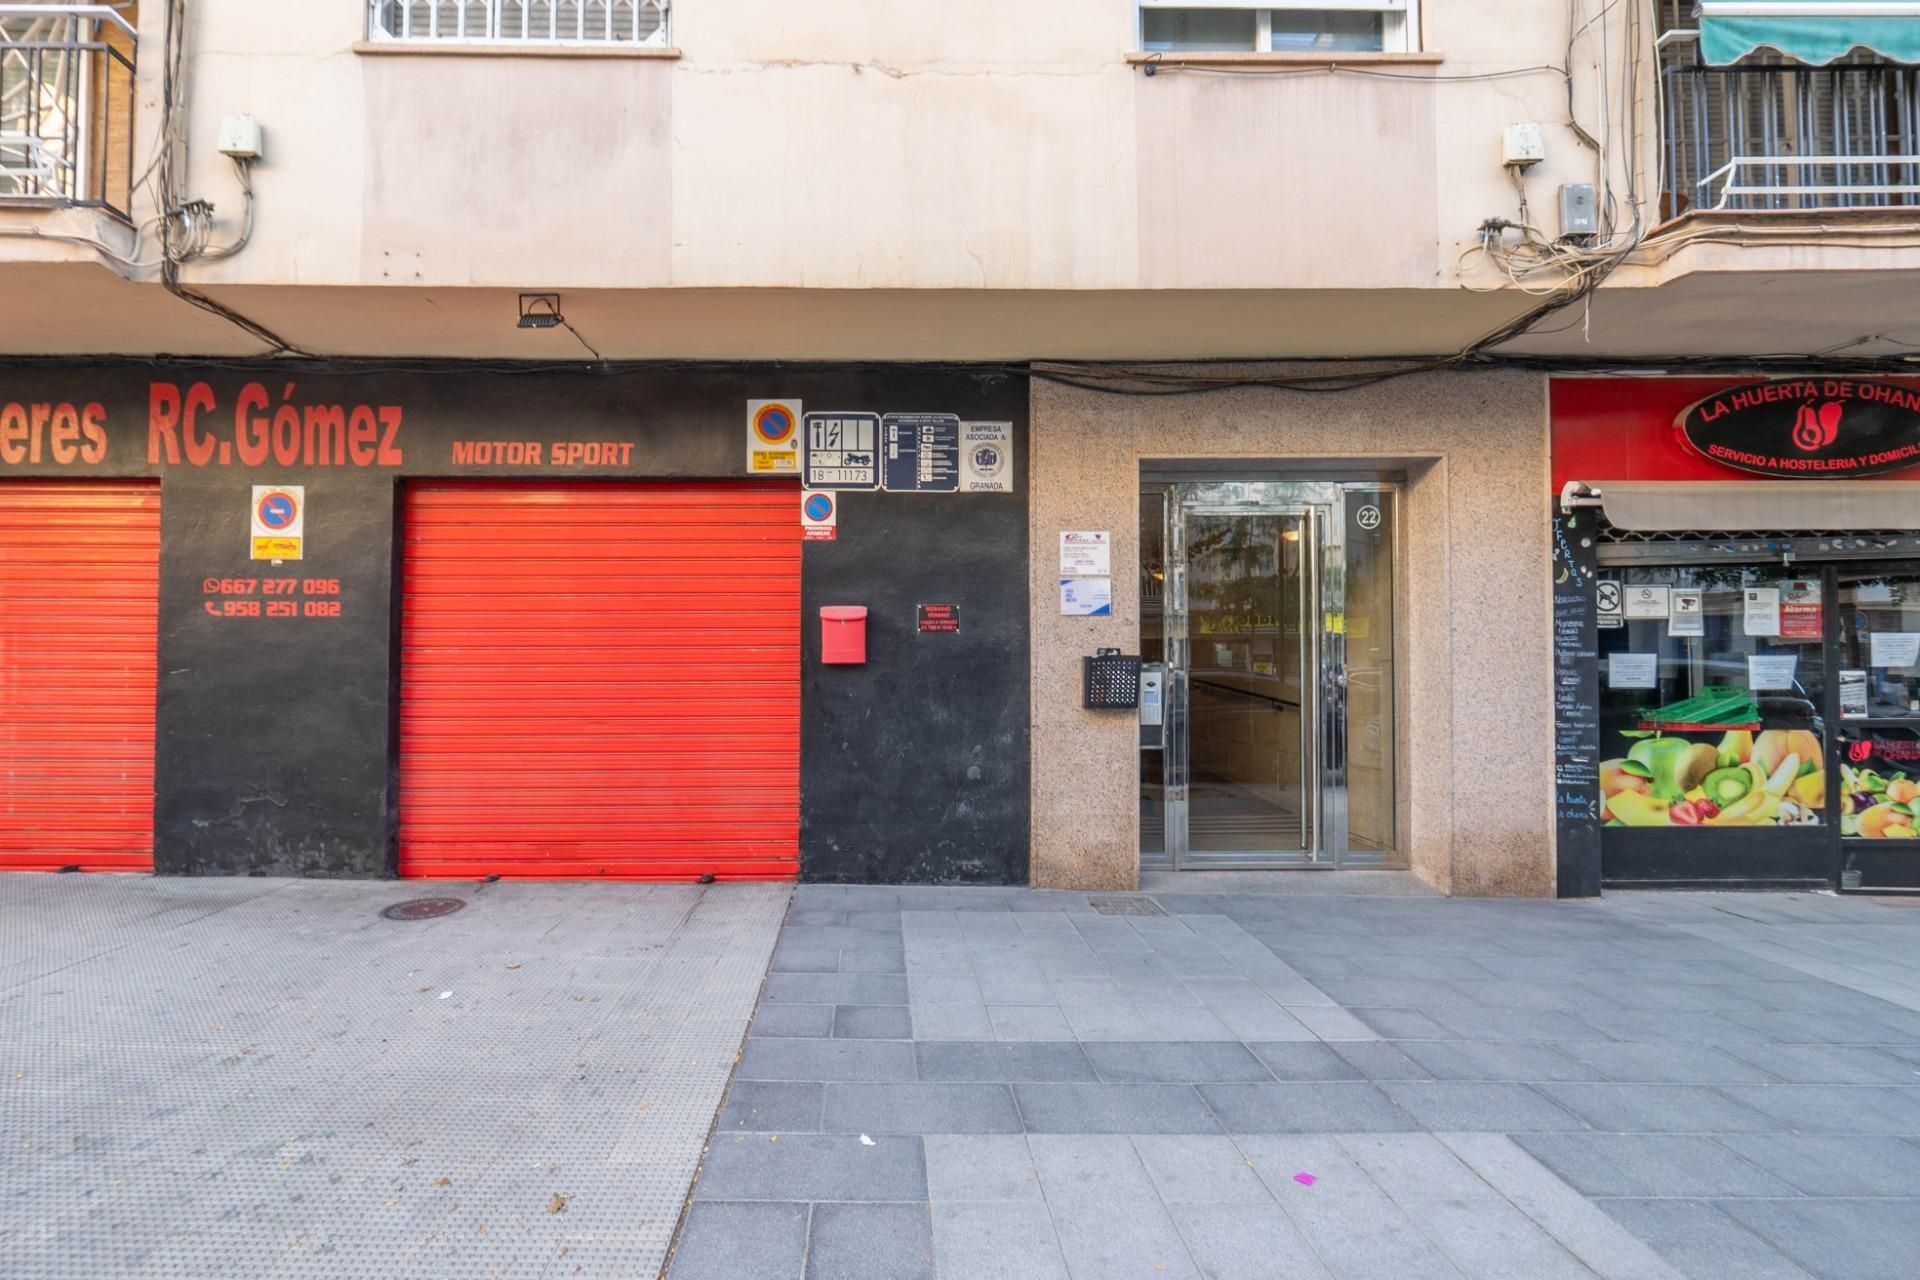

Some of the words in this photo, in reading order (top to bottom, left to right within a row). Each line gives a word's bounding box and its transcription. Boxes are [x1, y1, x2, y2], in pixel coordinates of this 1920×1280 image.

[1700, 401, 1730, 421] LA
[1731, 382, 1818, 411] HUERTA
[1824, 381, 1853, 397] DE
[0, 402, 107, 464] eres
[148, 382, 403, 466] RC.Gómez
[970, 425, 1002, 433] EMPRESA
[966, 433, 999, 441] ASOCIADA
[452, 441, 542, 465] MOTOR
[551, 442, 634, 465] SPORT
[1709, 444, 1766, 466] SERVICIO
[1768, 457, 1777, 468] A
[1780, 457, 1857, 470] HOSTELERIA
[1858, 456, 1867, 467] Y
[813, 469, 825, 481] 18
[837, 469, 868, 482] 11173
[969, 481, 1004, 490] GRANADA
[1361, 510, 1377, 525] 22
[220, 578, 258, 595] 667
[262, 578, 298, 595] 277
[303, 578, 340, 595] 096
[223, 600, 260, 617] 958
[265, 600, 298, 617] 251
[303, 600, 341, 617] 082
[1784, 605, 1816, 613] Alarma
